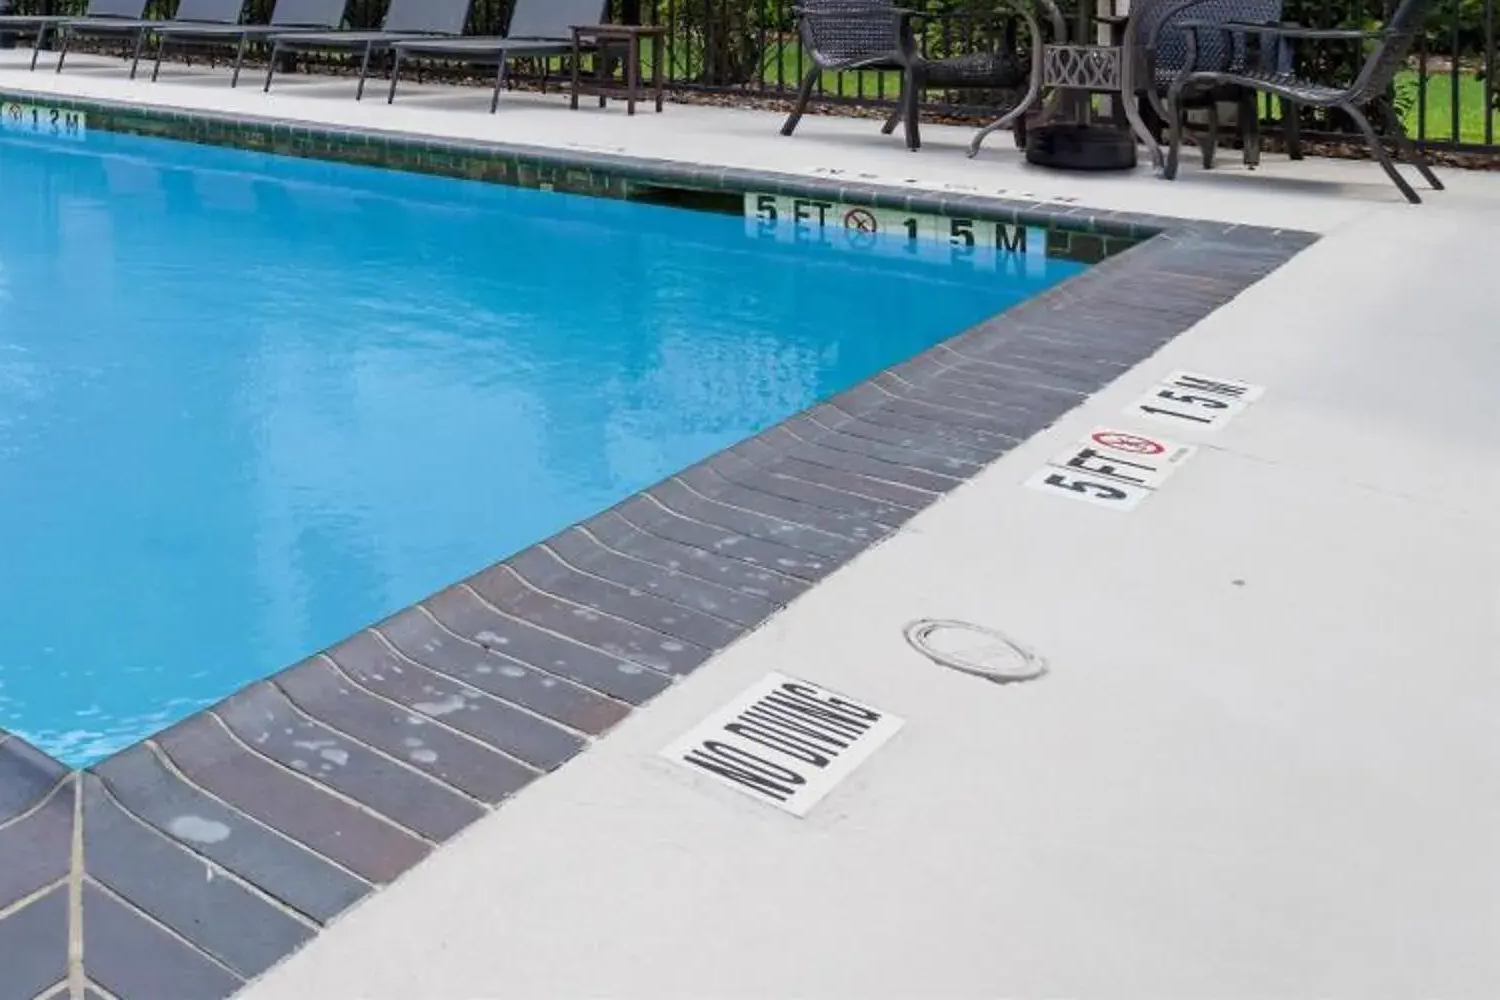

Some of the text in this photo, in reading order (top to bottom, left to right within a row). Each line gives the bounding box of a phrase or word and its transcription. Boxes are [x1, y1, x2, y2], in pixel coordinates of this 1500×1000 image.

[756, 195, 777, 220] 5
[794, 200, 832, 227] FT
[683, 683, 883, 803] NO DIVING
